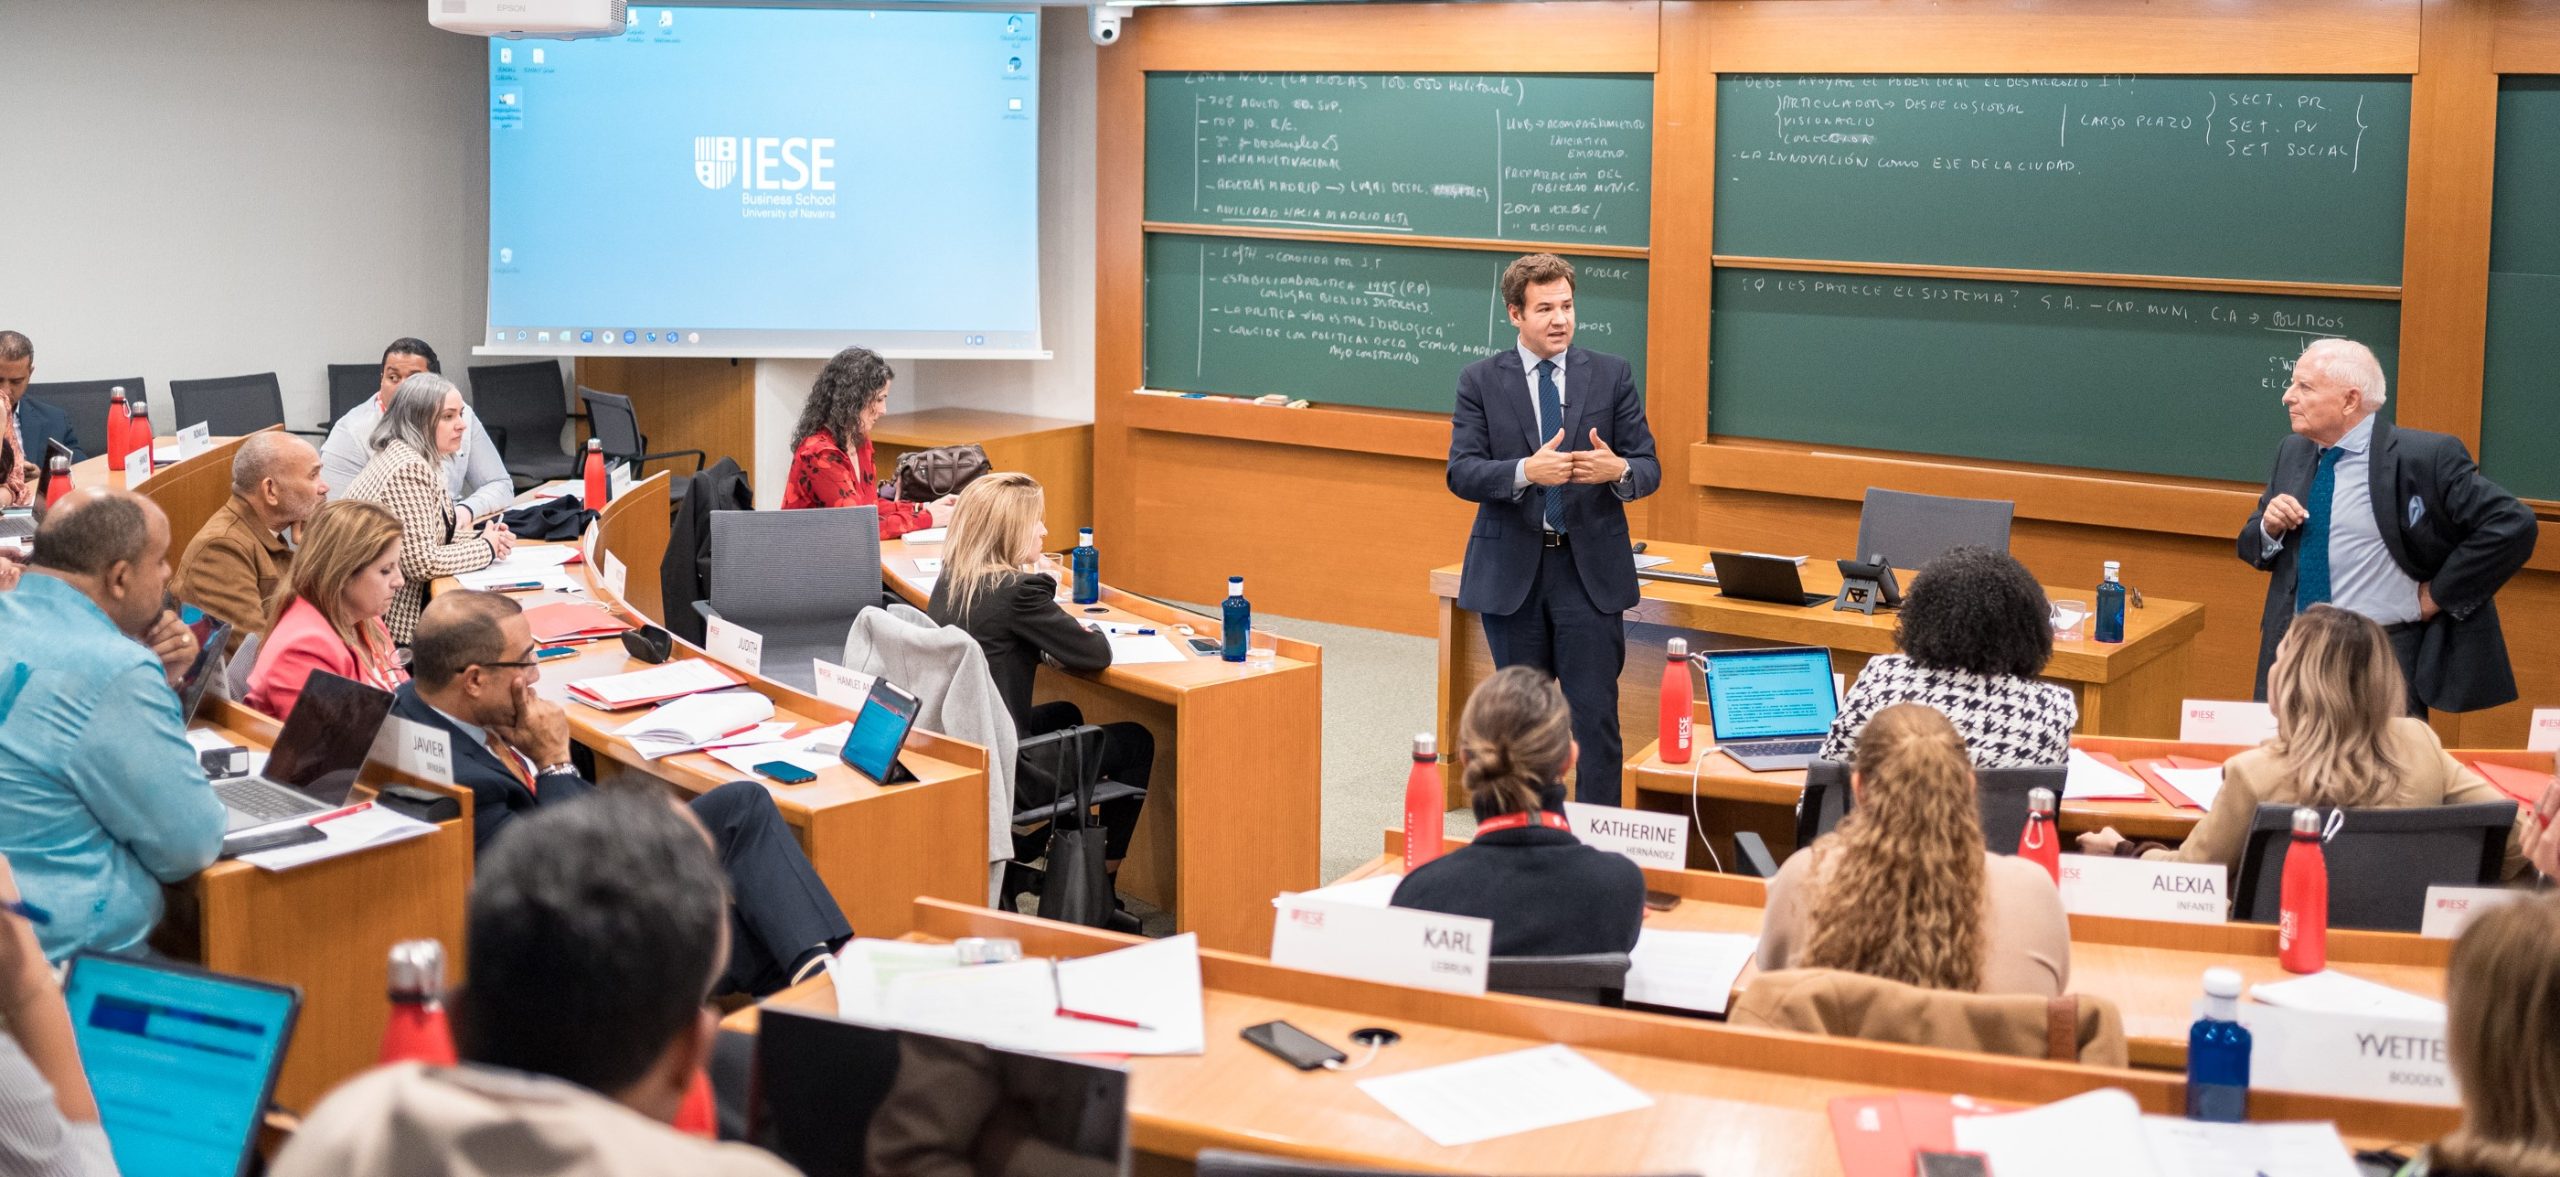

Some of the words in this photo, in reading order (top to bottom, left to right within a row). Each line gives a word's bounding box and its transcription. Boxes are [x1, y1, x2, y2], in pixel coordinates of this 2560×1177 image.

[742, 137, 836, 190] IESE
[742, 192, 793, 206] Business
[795, 192, 836, 206] School
[742, 207, 787, 220] University
[788, 207, 798, 219] of
[800, 208, 836, 220] Navarra
[738, 637, 759, 657] JUDITH
[2199, 711, 2216, 719] IESE
[1679, 716, 1688, 738] IESE
[413, 733, 445, 759] JAVIER
[1590, 818, 1677, 845] KATHERINE
[1626, 845, 1675, 861] HERNÁNDEZ
[2152, 874, 2216, 895] ALEXIA
[2177, 901, 2216, 913] INFANTE
[1423, 926, 1476, 955] KARL
[2355, 1032, 2447, 1064] YVETTE
